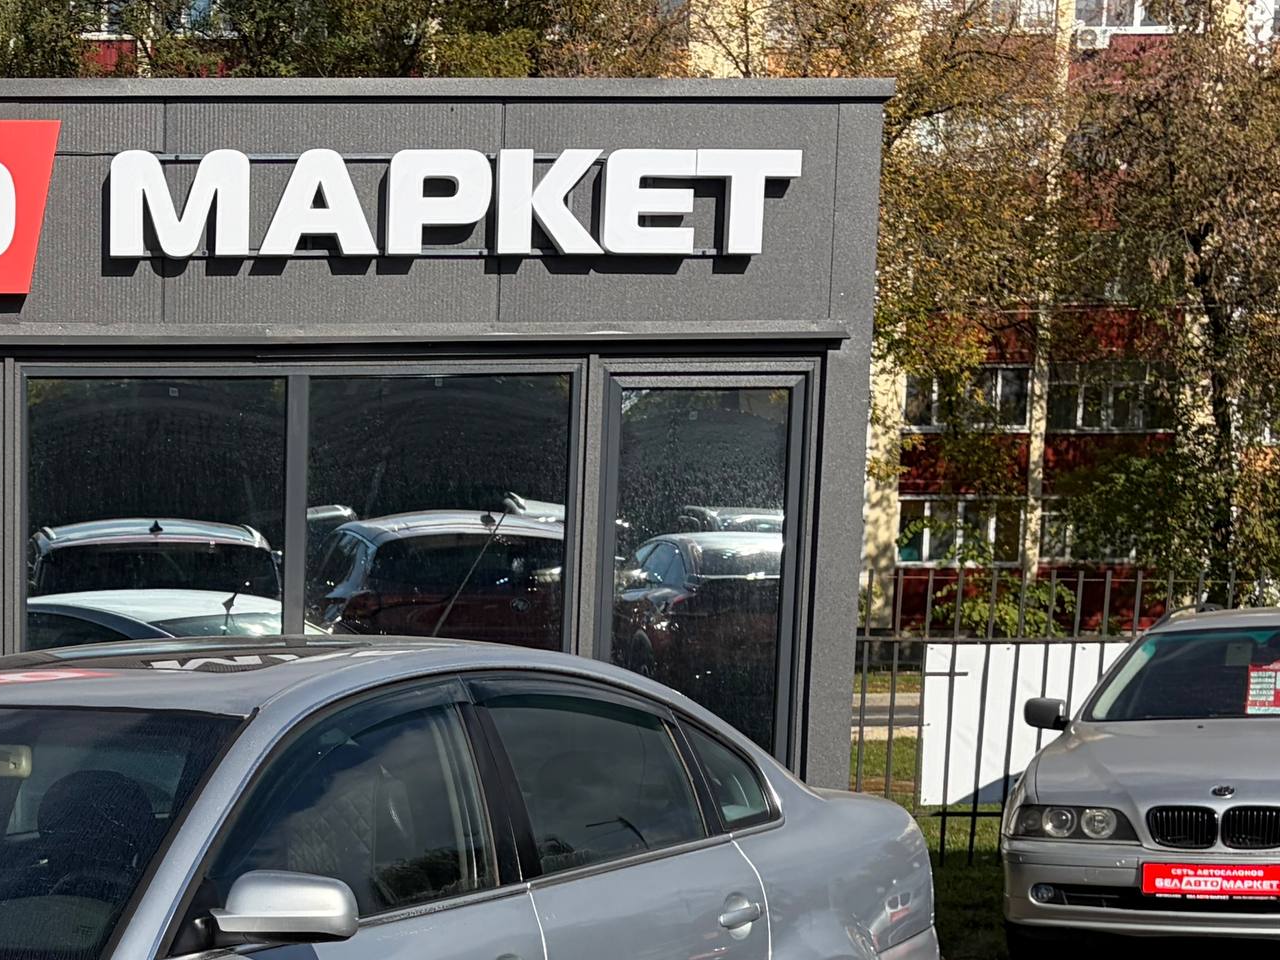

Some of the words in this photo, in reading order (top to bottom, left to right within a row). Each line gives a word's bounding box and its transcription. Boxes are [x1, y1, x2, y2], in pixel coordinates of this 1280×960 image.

[108, 148, 803, 258] МАРКЕТ
[1171, 868, 1195, 876] СЕТЬ
[1197, 869, 1264, 877] АВТОСАЛОНОВ
[1155, 878, 1181, 889] БЕЛ
[1183, 879, 1220, 888] АВТО
[1222, 879, 1279, 890] МАРКЕТ
